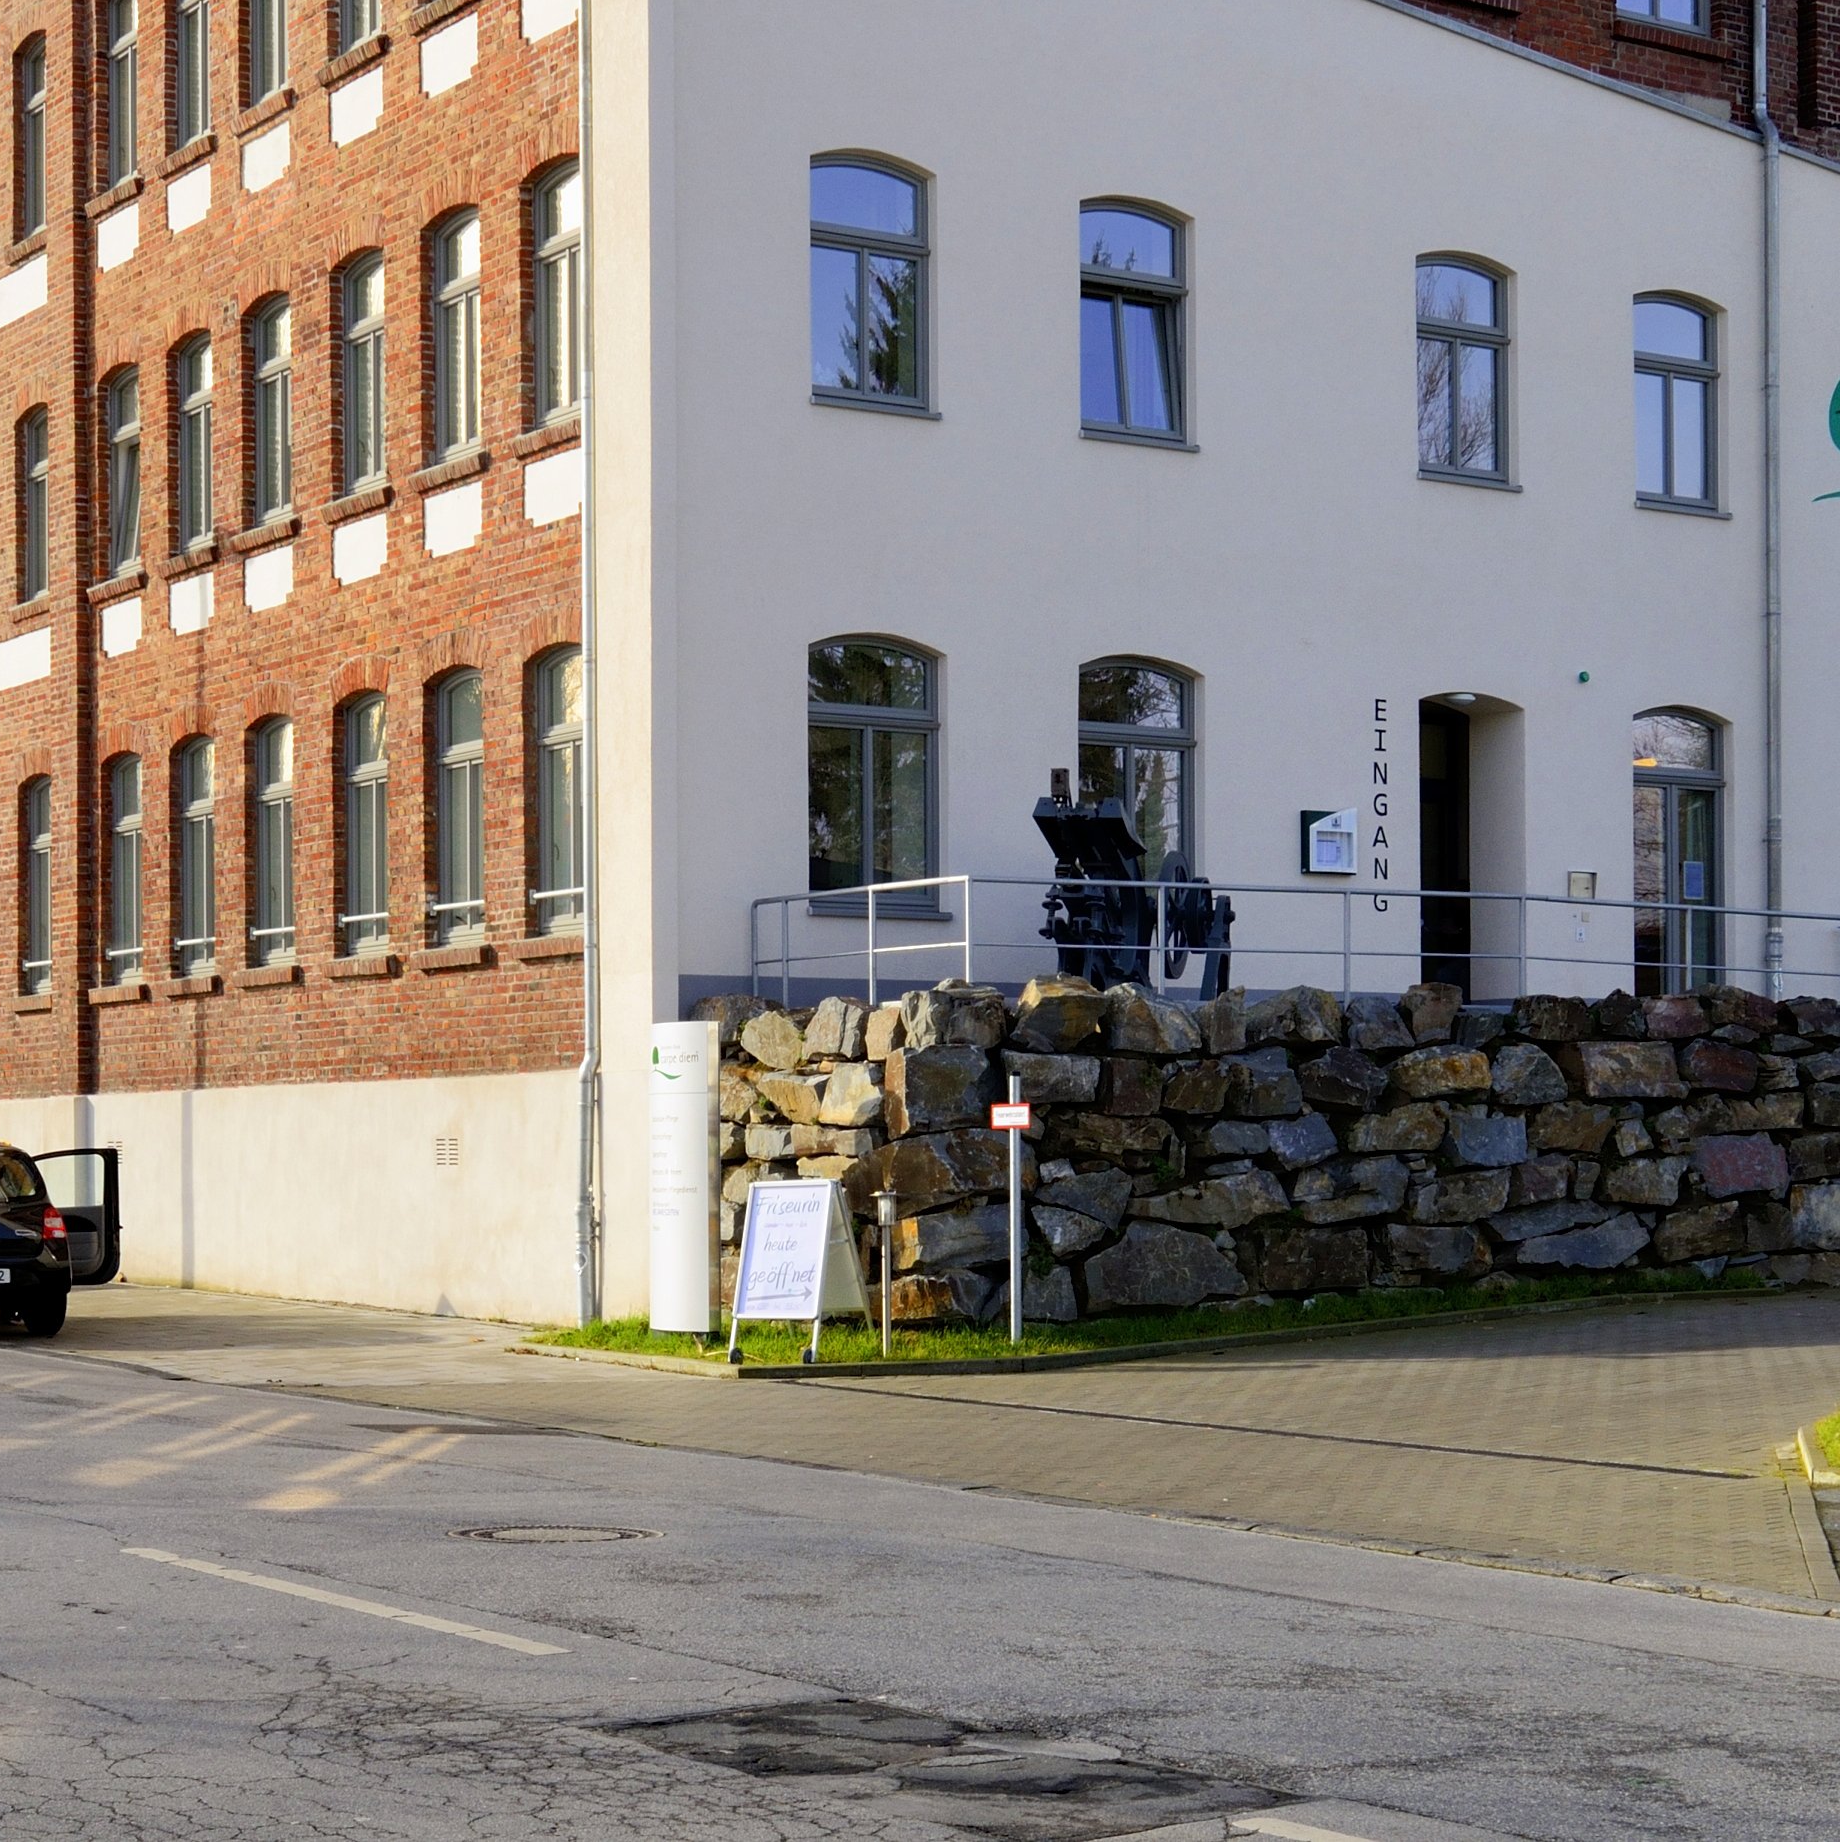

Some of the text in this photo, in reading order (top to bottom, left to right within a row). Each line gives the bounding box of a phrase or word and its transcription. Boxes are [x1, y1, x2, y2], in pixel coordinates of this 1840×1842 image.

[1372, 698, 1389, 913] EINGANG
[756, 1193, 821, 1216] Friseurin
[763, 1232, 798, 1252] heute
[746, 1260, 816, 1291] geöffnet
